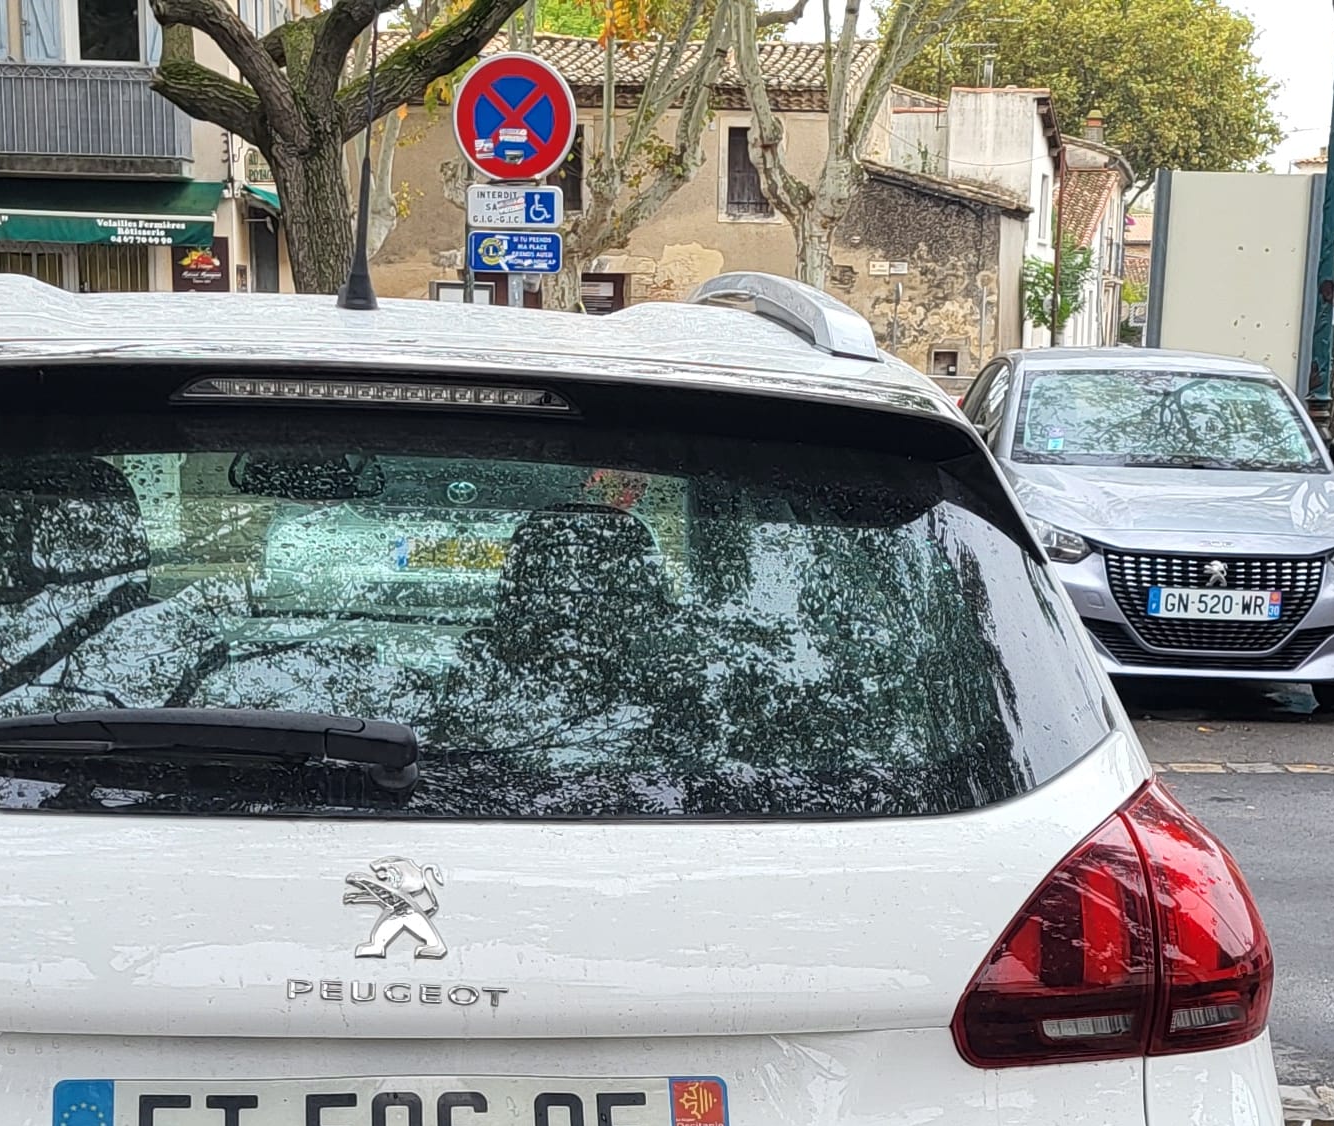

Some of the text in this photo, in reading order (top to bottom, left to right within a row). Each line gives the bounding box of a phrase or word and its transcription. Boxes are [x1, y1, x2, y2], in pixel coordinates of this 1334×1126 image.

[476, 191, 517, 199] INTERDIT
[96, 219, 137, 228] Volailles
[1164, 592, 1265, 616] GN-520-WR
[1268, 604, 1280, 616] 30
[286, 978, 509, 1008] PEUGEOT
